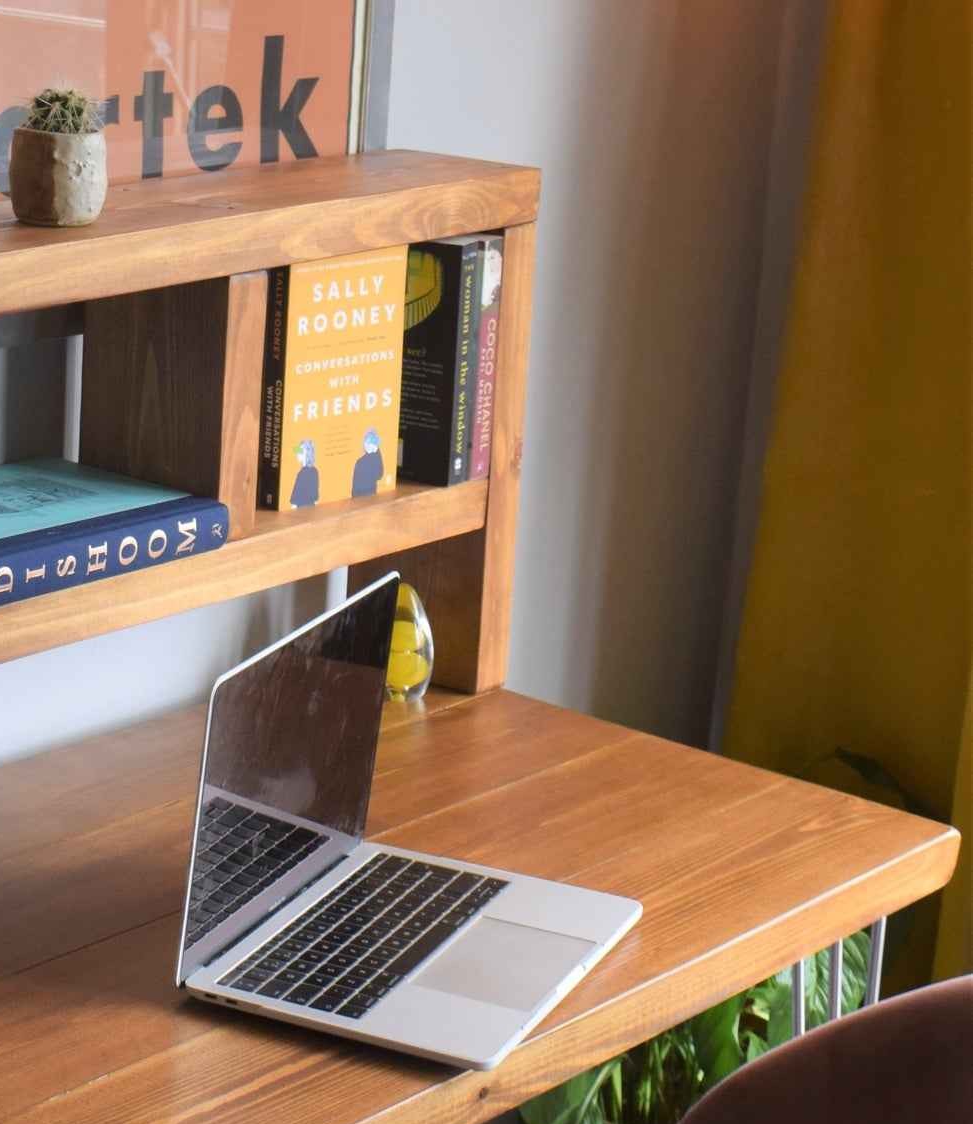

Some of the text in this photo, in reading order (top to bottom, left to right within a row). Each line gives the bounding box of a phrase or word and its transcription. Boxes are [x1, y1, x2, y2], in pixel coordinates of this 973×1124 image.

[312, 274, 385, 303] SALLY
[273, 271, 284, 361] SALLY ROONEY
[297, 303, 397, 337] ROONEY
[295, 348, 395, 375] CONVERSATIONS
[329, 374, 360, 389] WITH
[456, 275, 472, 454] woman in the window
[480, 318, 497, 452] COCO CHANEL
[264, 386, 274, 459] WITH FRIENDS
[272, 379, 283, 468] CONVERSATIONS
[293, 388, 393, 423] FRIENDS
